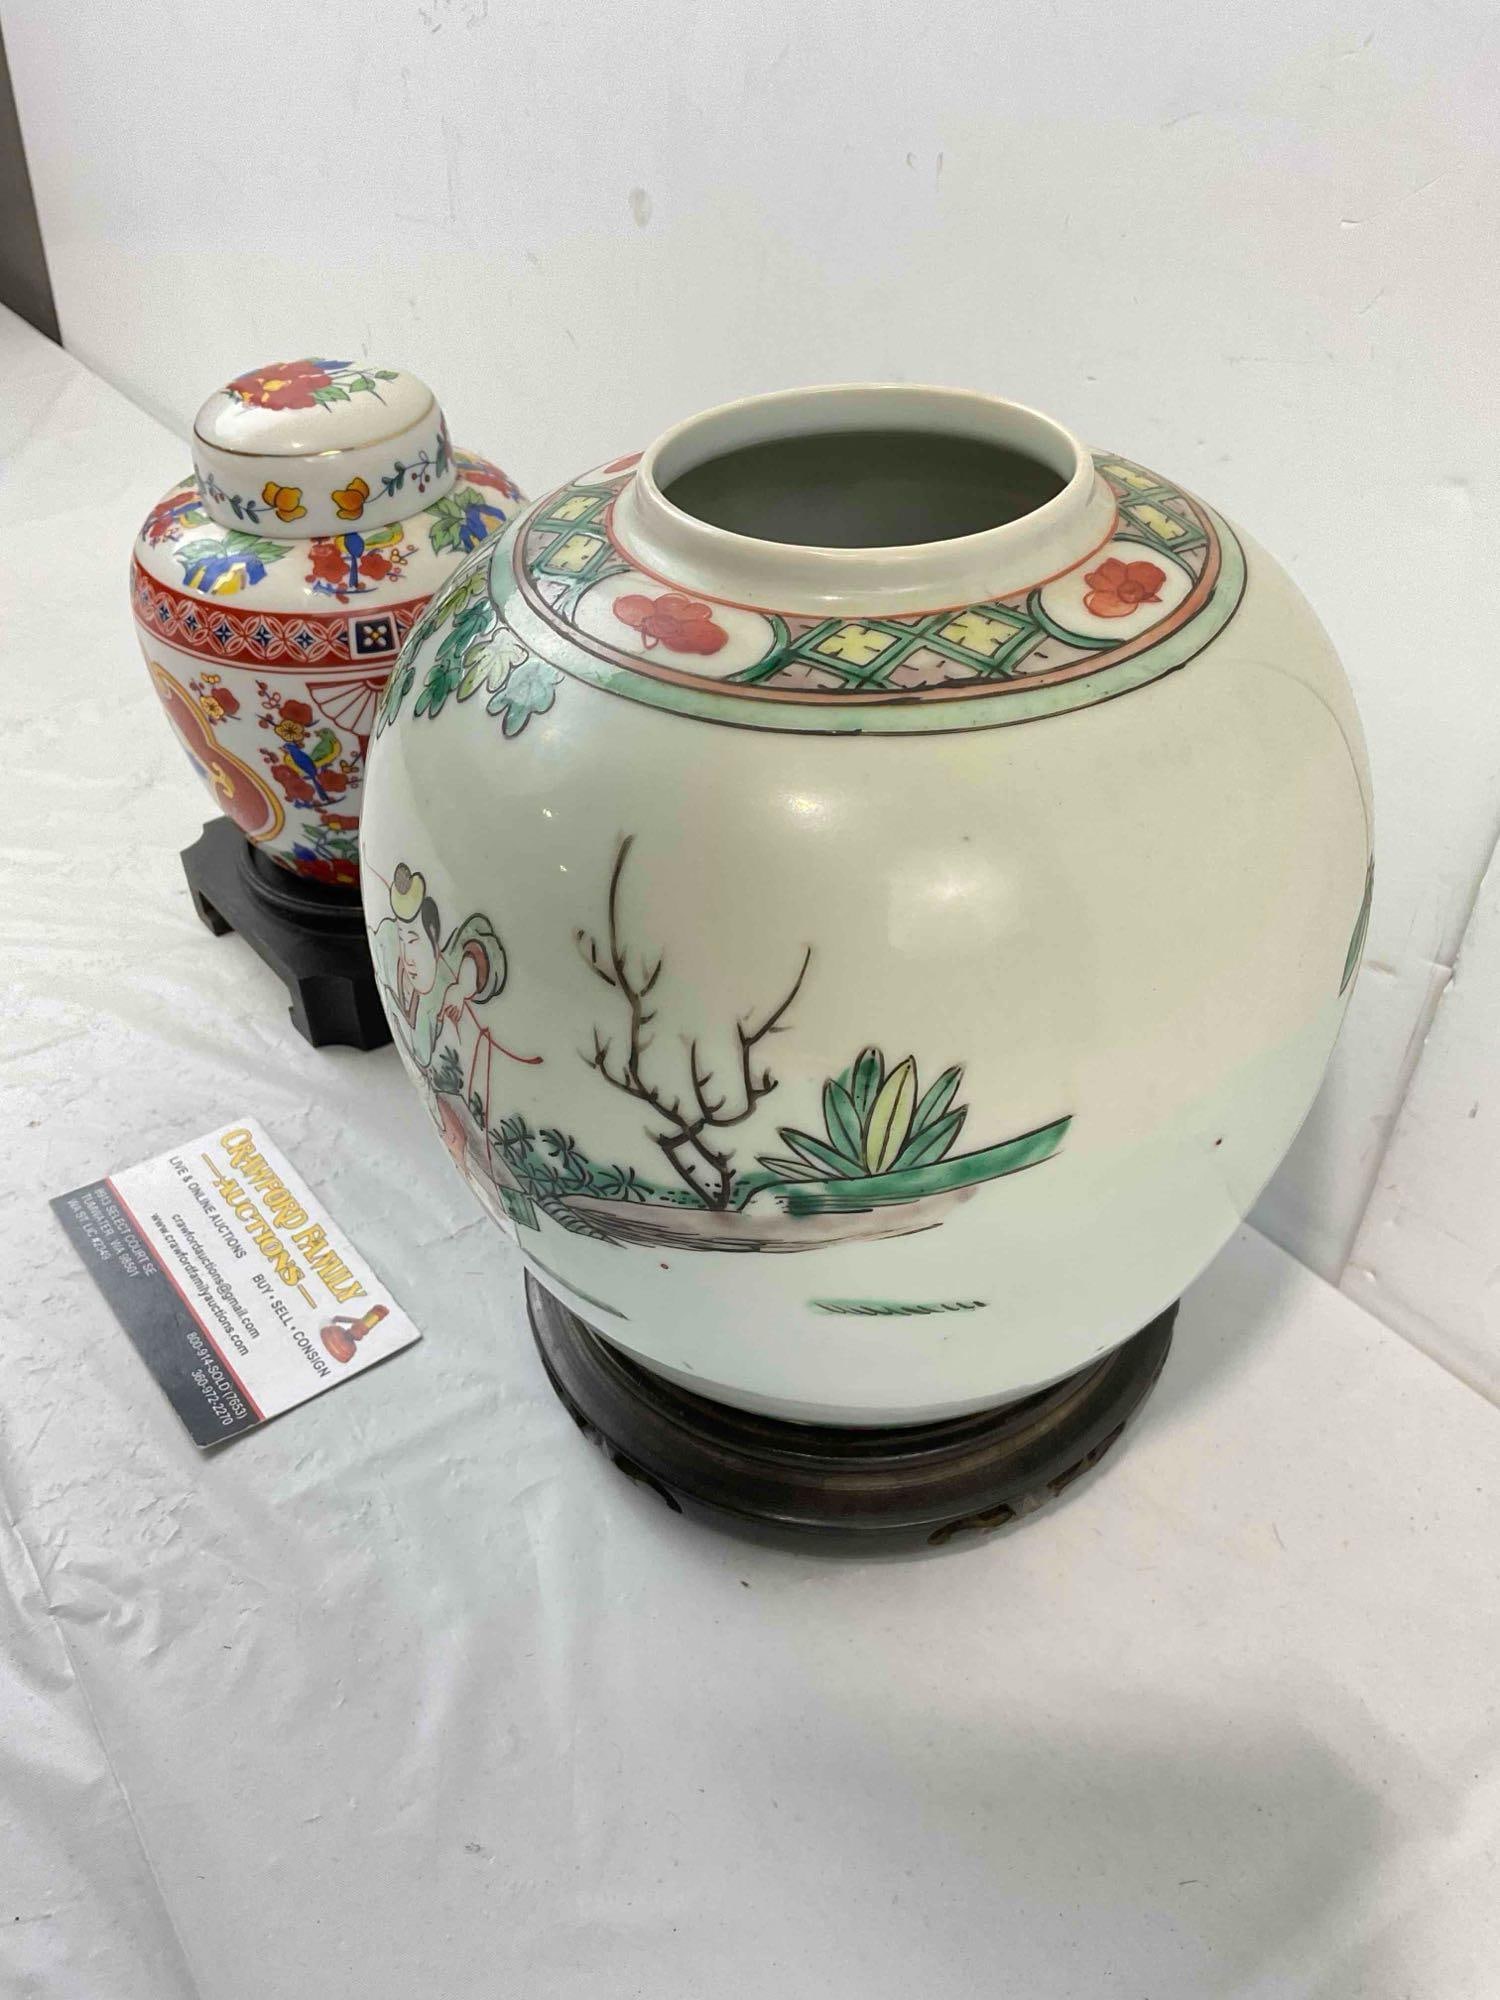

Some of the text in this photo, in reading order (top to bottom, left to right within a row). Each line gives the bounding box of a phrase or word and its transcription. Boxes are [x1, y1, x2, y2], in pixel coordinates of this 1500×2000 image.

[125, 1234, 150, 1263] COURT
[142, 1262, 157, 1276] SE
[169, 1157, 188, 1175] LIVE
[187, 1182, 216, 1213] ONLINE
[210, 1214, 247, 1259] AUCTIONS
[213, 1176, 306, 1286] AUCTIONS
[219, 1127, 368, 1305] CRAWFORD FAMILY
[149, 1213, 250, 1356] www.crawfordfamilyauctions.com
[170, 1213, 261, 1339] crawfordauctions@gmail.com
[252, 1274, 330, 1377] BUY SELL CONSIGN
[185, 1331, 249, 1420] 800-914-SOLD (7653)
[190, 1368, 234, 1426] 360-972-2270
